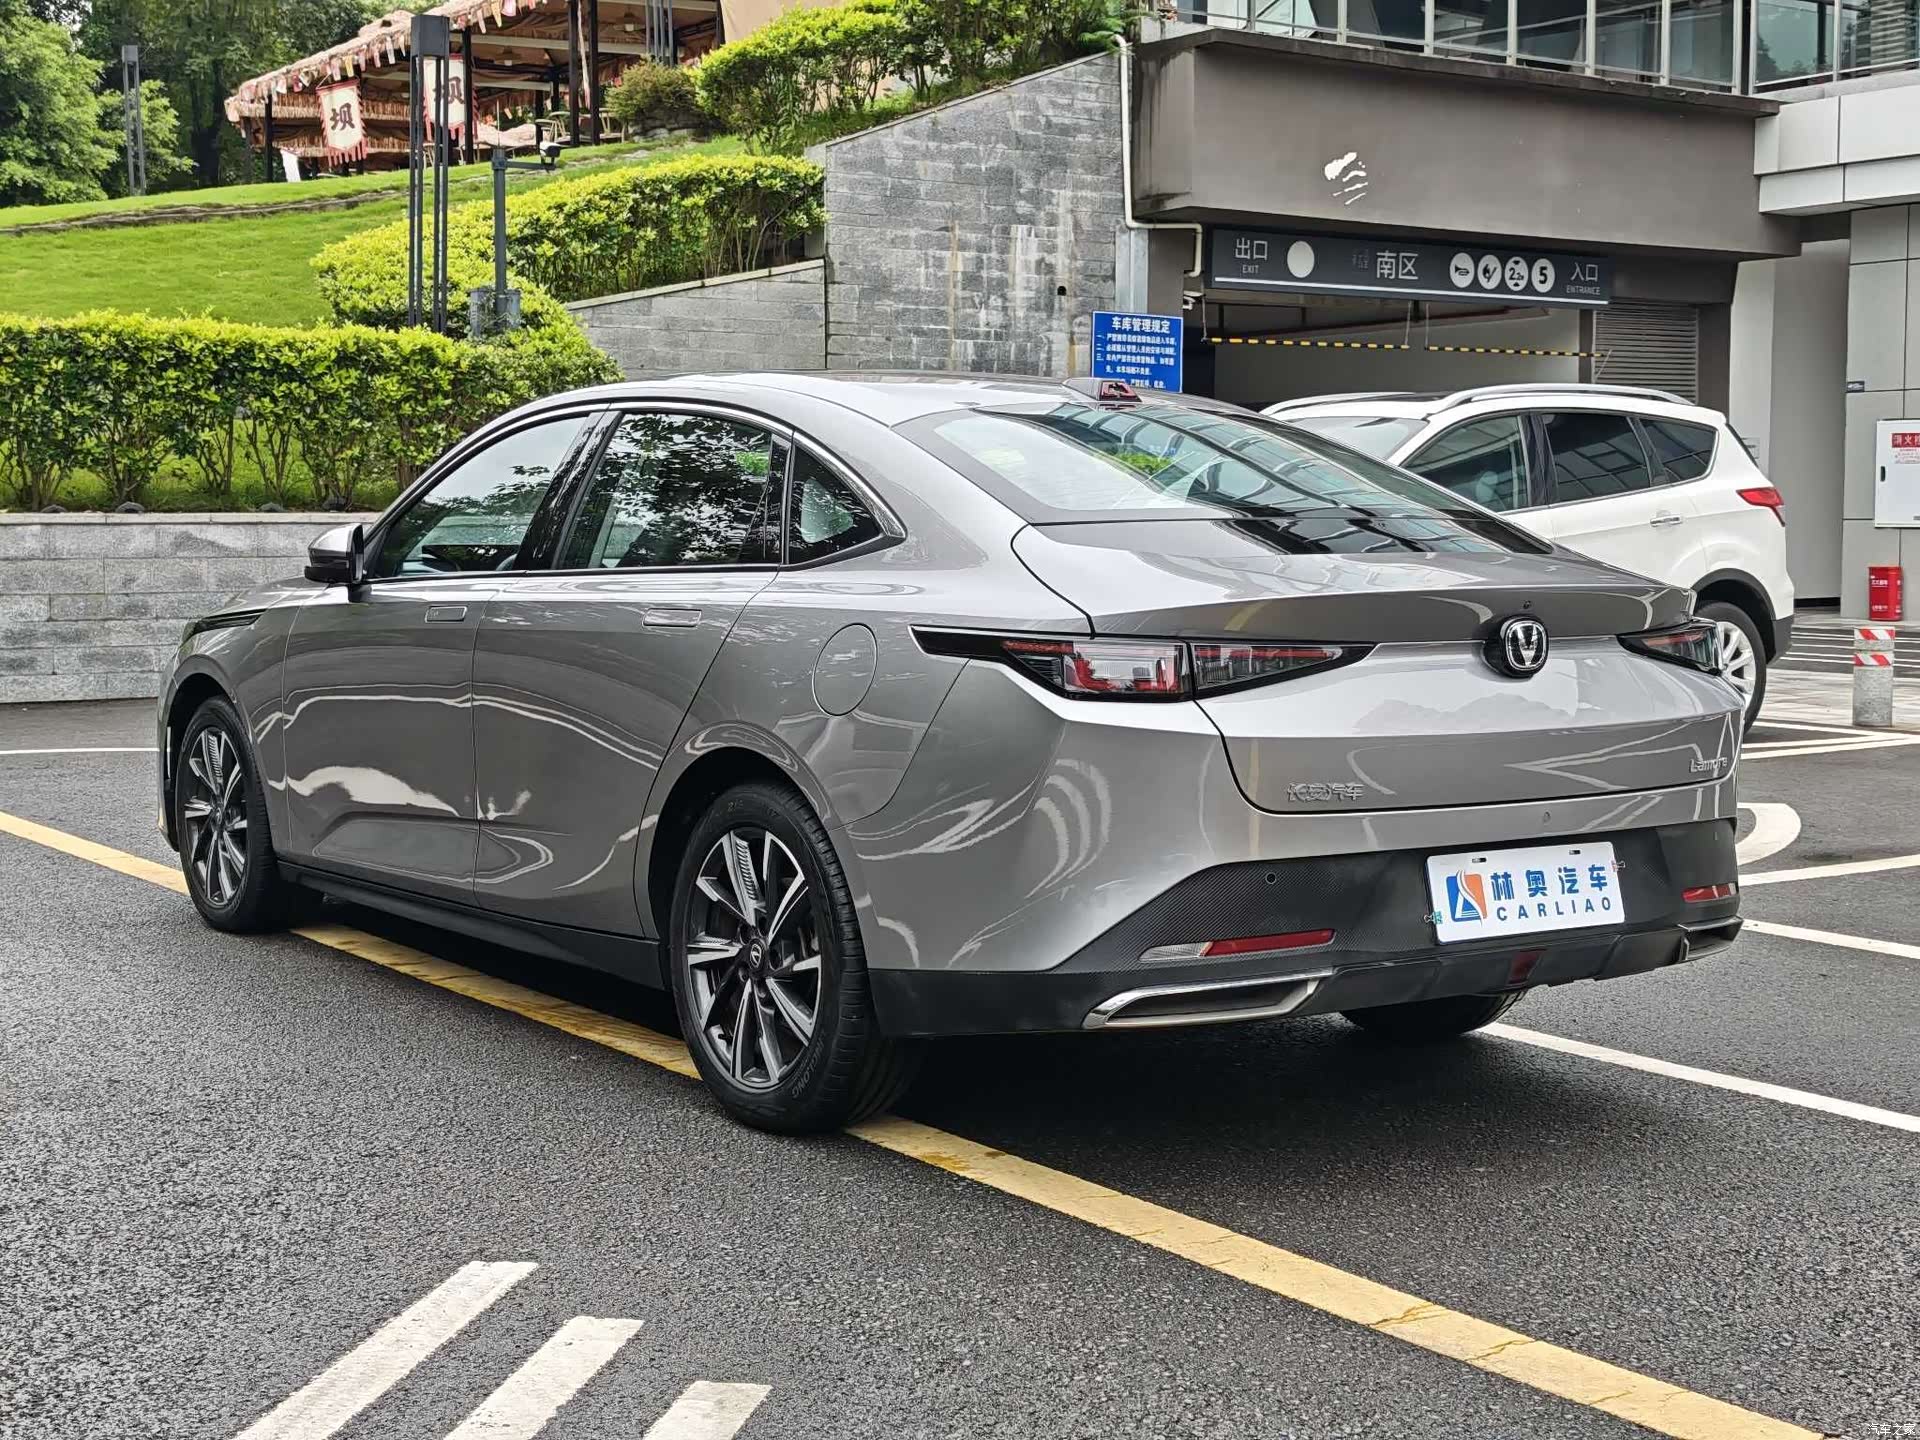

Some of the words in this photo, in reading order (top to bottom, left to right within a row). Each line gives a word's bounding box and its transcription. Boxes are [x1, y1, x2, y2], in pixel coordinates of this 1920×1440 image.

[330, 102, 355, 131] 坝
[1234, 237, 1268, 260] 出口
[1242, 264, 1259, 274] EXIT
[1376, 250, 1419, 279] 南区
[1538, 266, 1548, 284] 5
[1570, 262, 1599, 282] 入口
[1566, 284, 1601, 296] ENTRANCE
[1111, 316, 1171, 334] 车库管理规定
[1490, 864, 1608, 901] 林奥汽车
[1496, 897, 1611, 921] CARLIAO
